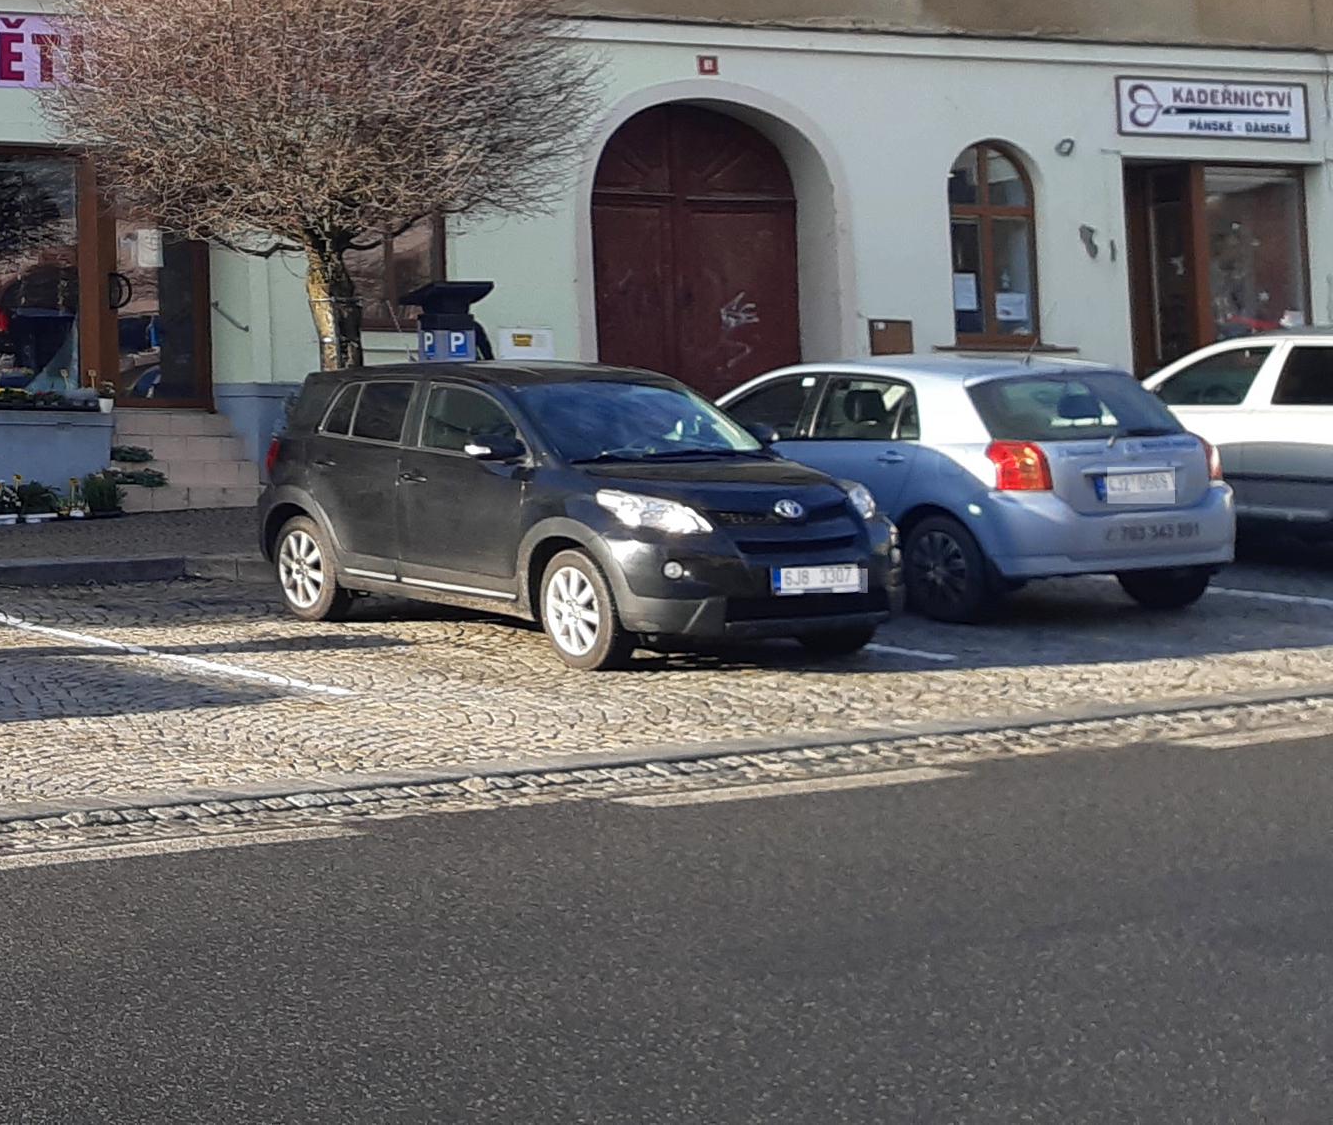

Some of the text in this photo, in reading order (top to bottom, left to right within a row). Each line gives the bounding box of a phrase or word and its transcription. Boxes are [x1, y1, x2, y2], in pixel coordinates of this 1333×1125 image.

[1172, 83, 1292, 107] KADEŘNICTVÍ
[1188, 118, 1233, 132] PÁNSKÉ
[424, 332, 434, 352] P
[450, 332, 465, 353] P
